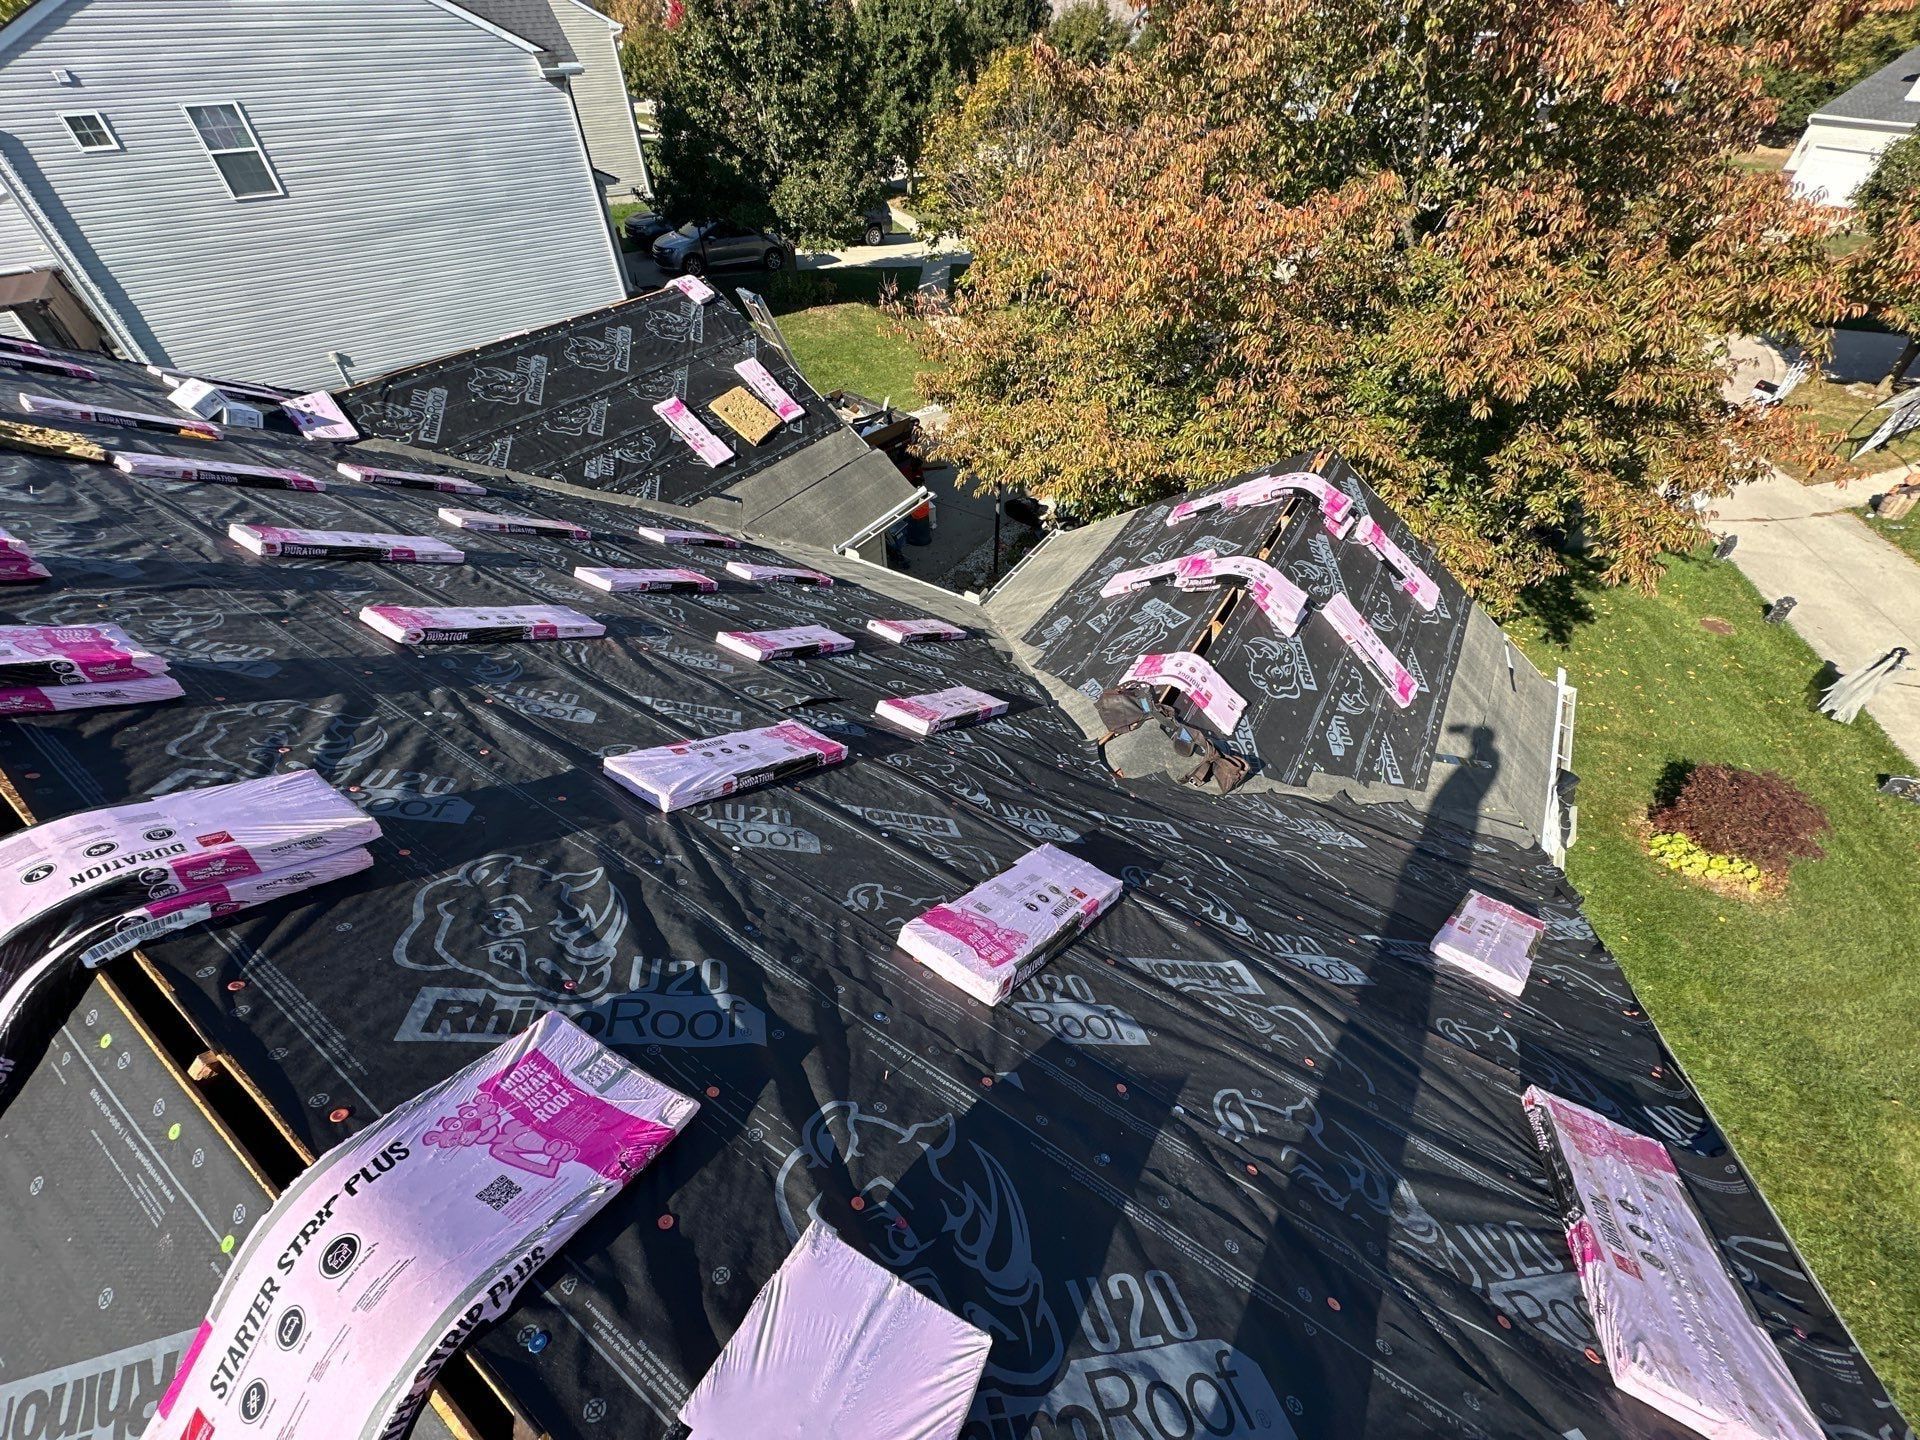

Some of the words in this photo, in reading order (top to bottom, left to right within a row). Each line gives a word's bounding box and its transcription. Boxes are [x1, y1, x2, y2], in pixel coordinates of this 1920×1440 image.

[516, 355, 532, 374] U20
[529, 356, 547, 403] RhinoRoof
[410, 388, 428, 409] U20
[424, 389, 446, 440] RhinoRoof
[98, 415, 138, 428] DURATION
[200, 472, 239, 483] DURATION
[284, 545, 328, 557] DURATION
[426, 631, 469, 643] DURATION
[1177, 669, 1205, 693] PROEDGE
[360, 768, 458, 798] U20
[724, 803, 792, 826] U20
[68, 842, 188, 888] DURATION
[628, 955, 729, 994] U20
[1020, 974, 1096, 1004] U20
[499, 1059, 542, 1093] MORE
[510, 1070, 554, 1103] THAN
[525, 1087, 556, 1112] JUST
[554, 1084, 564, 1097] A
[531, 1091, 576, 1124] ROOF
[123, 1134, 176, 1203] www.eavetopeak.com
[1588, 1193, 1626, 1252] DURATION
[1455, 1220, 1564, 1279] U20
[209, 1276, 282, 1400] STARTER
[344, 1141, 411, 1197] PLUS
[486, 1245, 546, 1310] PLUS
[1065, 1269, 1199, 1353] U20
[584, 1300, 593, 1308] La
[589, 1305, 613, 1330] resistencia
[615, 1332, 631, 1348] desliz
[627, 1345, 643, 1360] puede
[641, 1359, 657, 1376] variar
[654, 1373, 664, 1382] de
[661, 1380, 682, 1401] acuerdo
[592, 1322, 601, 1331] Le
[645, 1378, 674, 1407] glissement
[636, 1339, 648, 1351] Slip
[645, 1348, 670, 1374] resistance
[666, 1372, 680, 1385] may
[676, 1382, 689, 1395] vary
